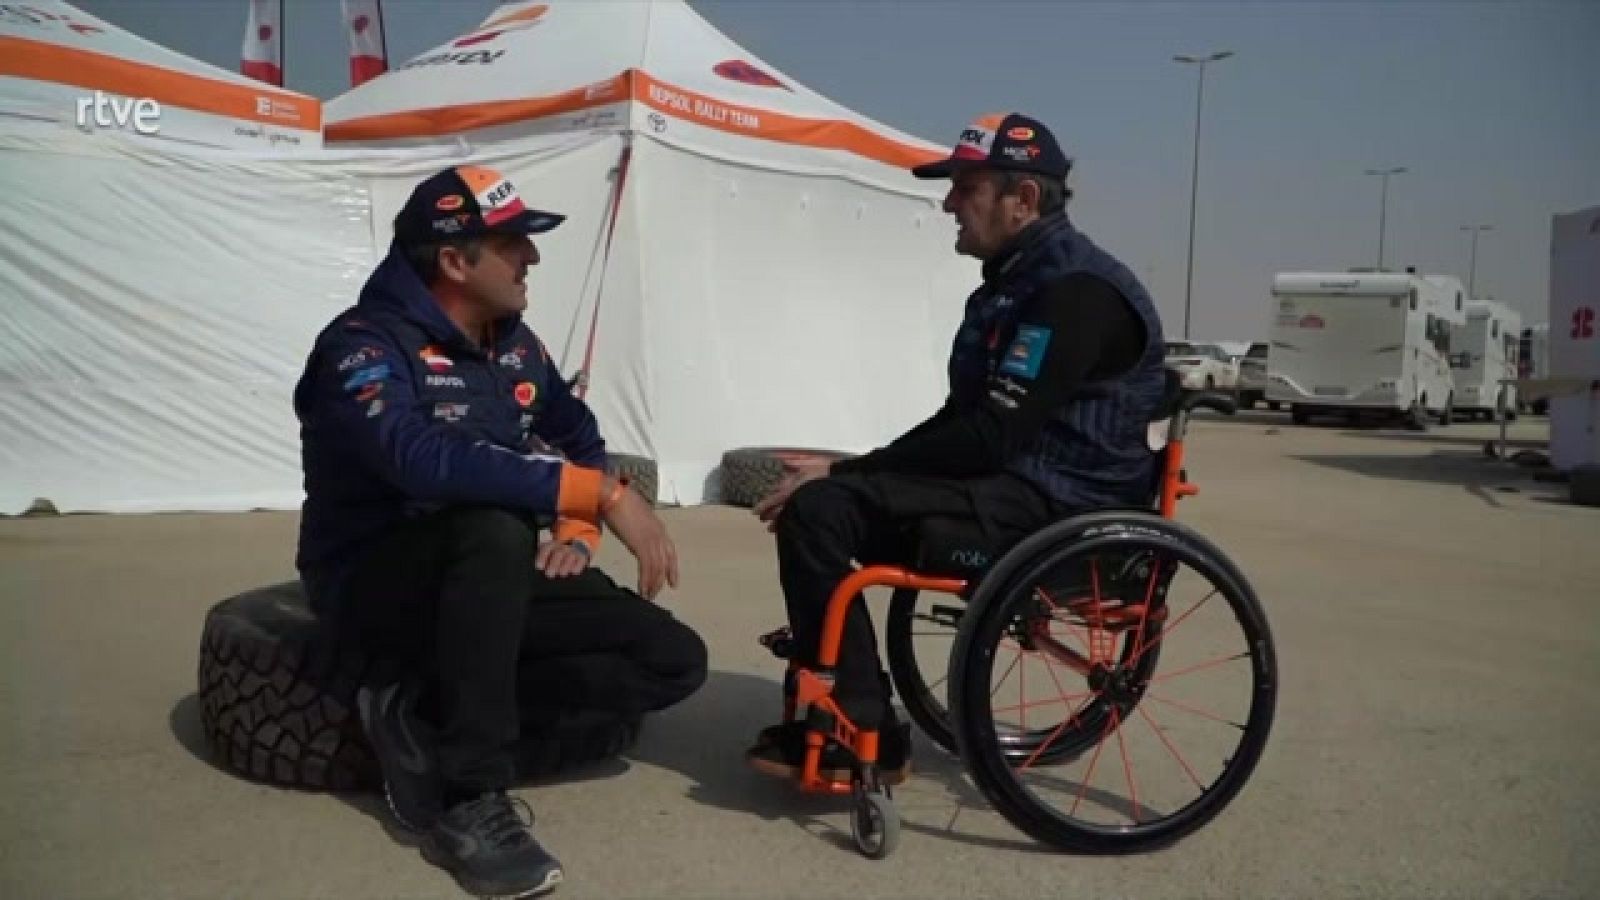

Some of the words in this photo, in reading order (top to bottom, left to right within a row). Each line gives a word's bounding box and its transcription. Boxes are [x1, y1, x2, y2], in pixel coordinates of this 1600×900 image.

[649, 84, 692, 112] REPSOL
[694, 99, 727, 122] RALLY
[729, 109, 760, 129] TEAM
